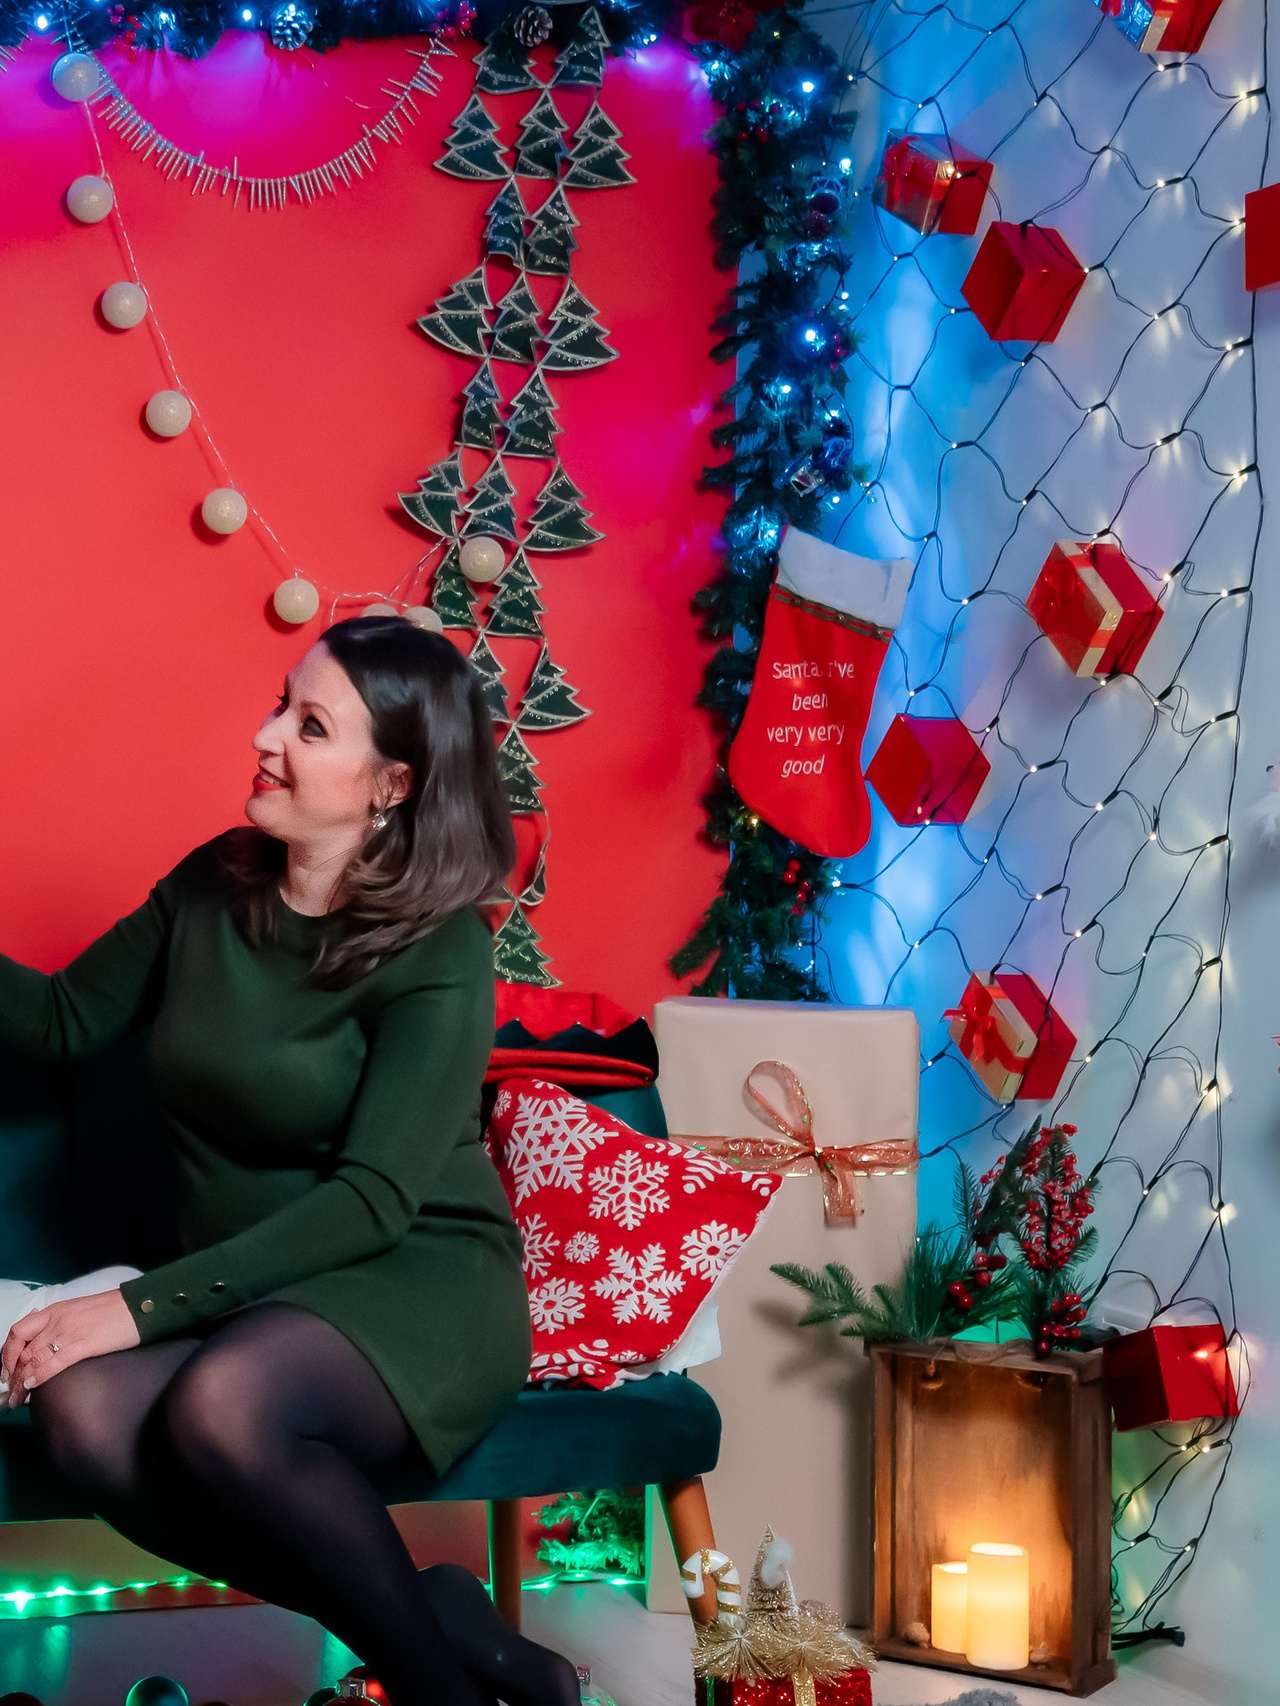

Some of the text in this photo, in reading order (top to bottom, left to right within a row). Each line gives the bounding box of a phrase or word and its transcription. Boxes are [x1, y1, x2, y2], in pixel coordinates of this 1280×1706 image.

[828, 660, 855, 679] I've
[792, 693, 829, 712] been
[767, 724, 845, 747] very very
[781, 753, 826, 778] good
